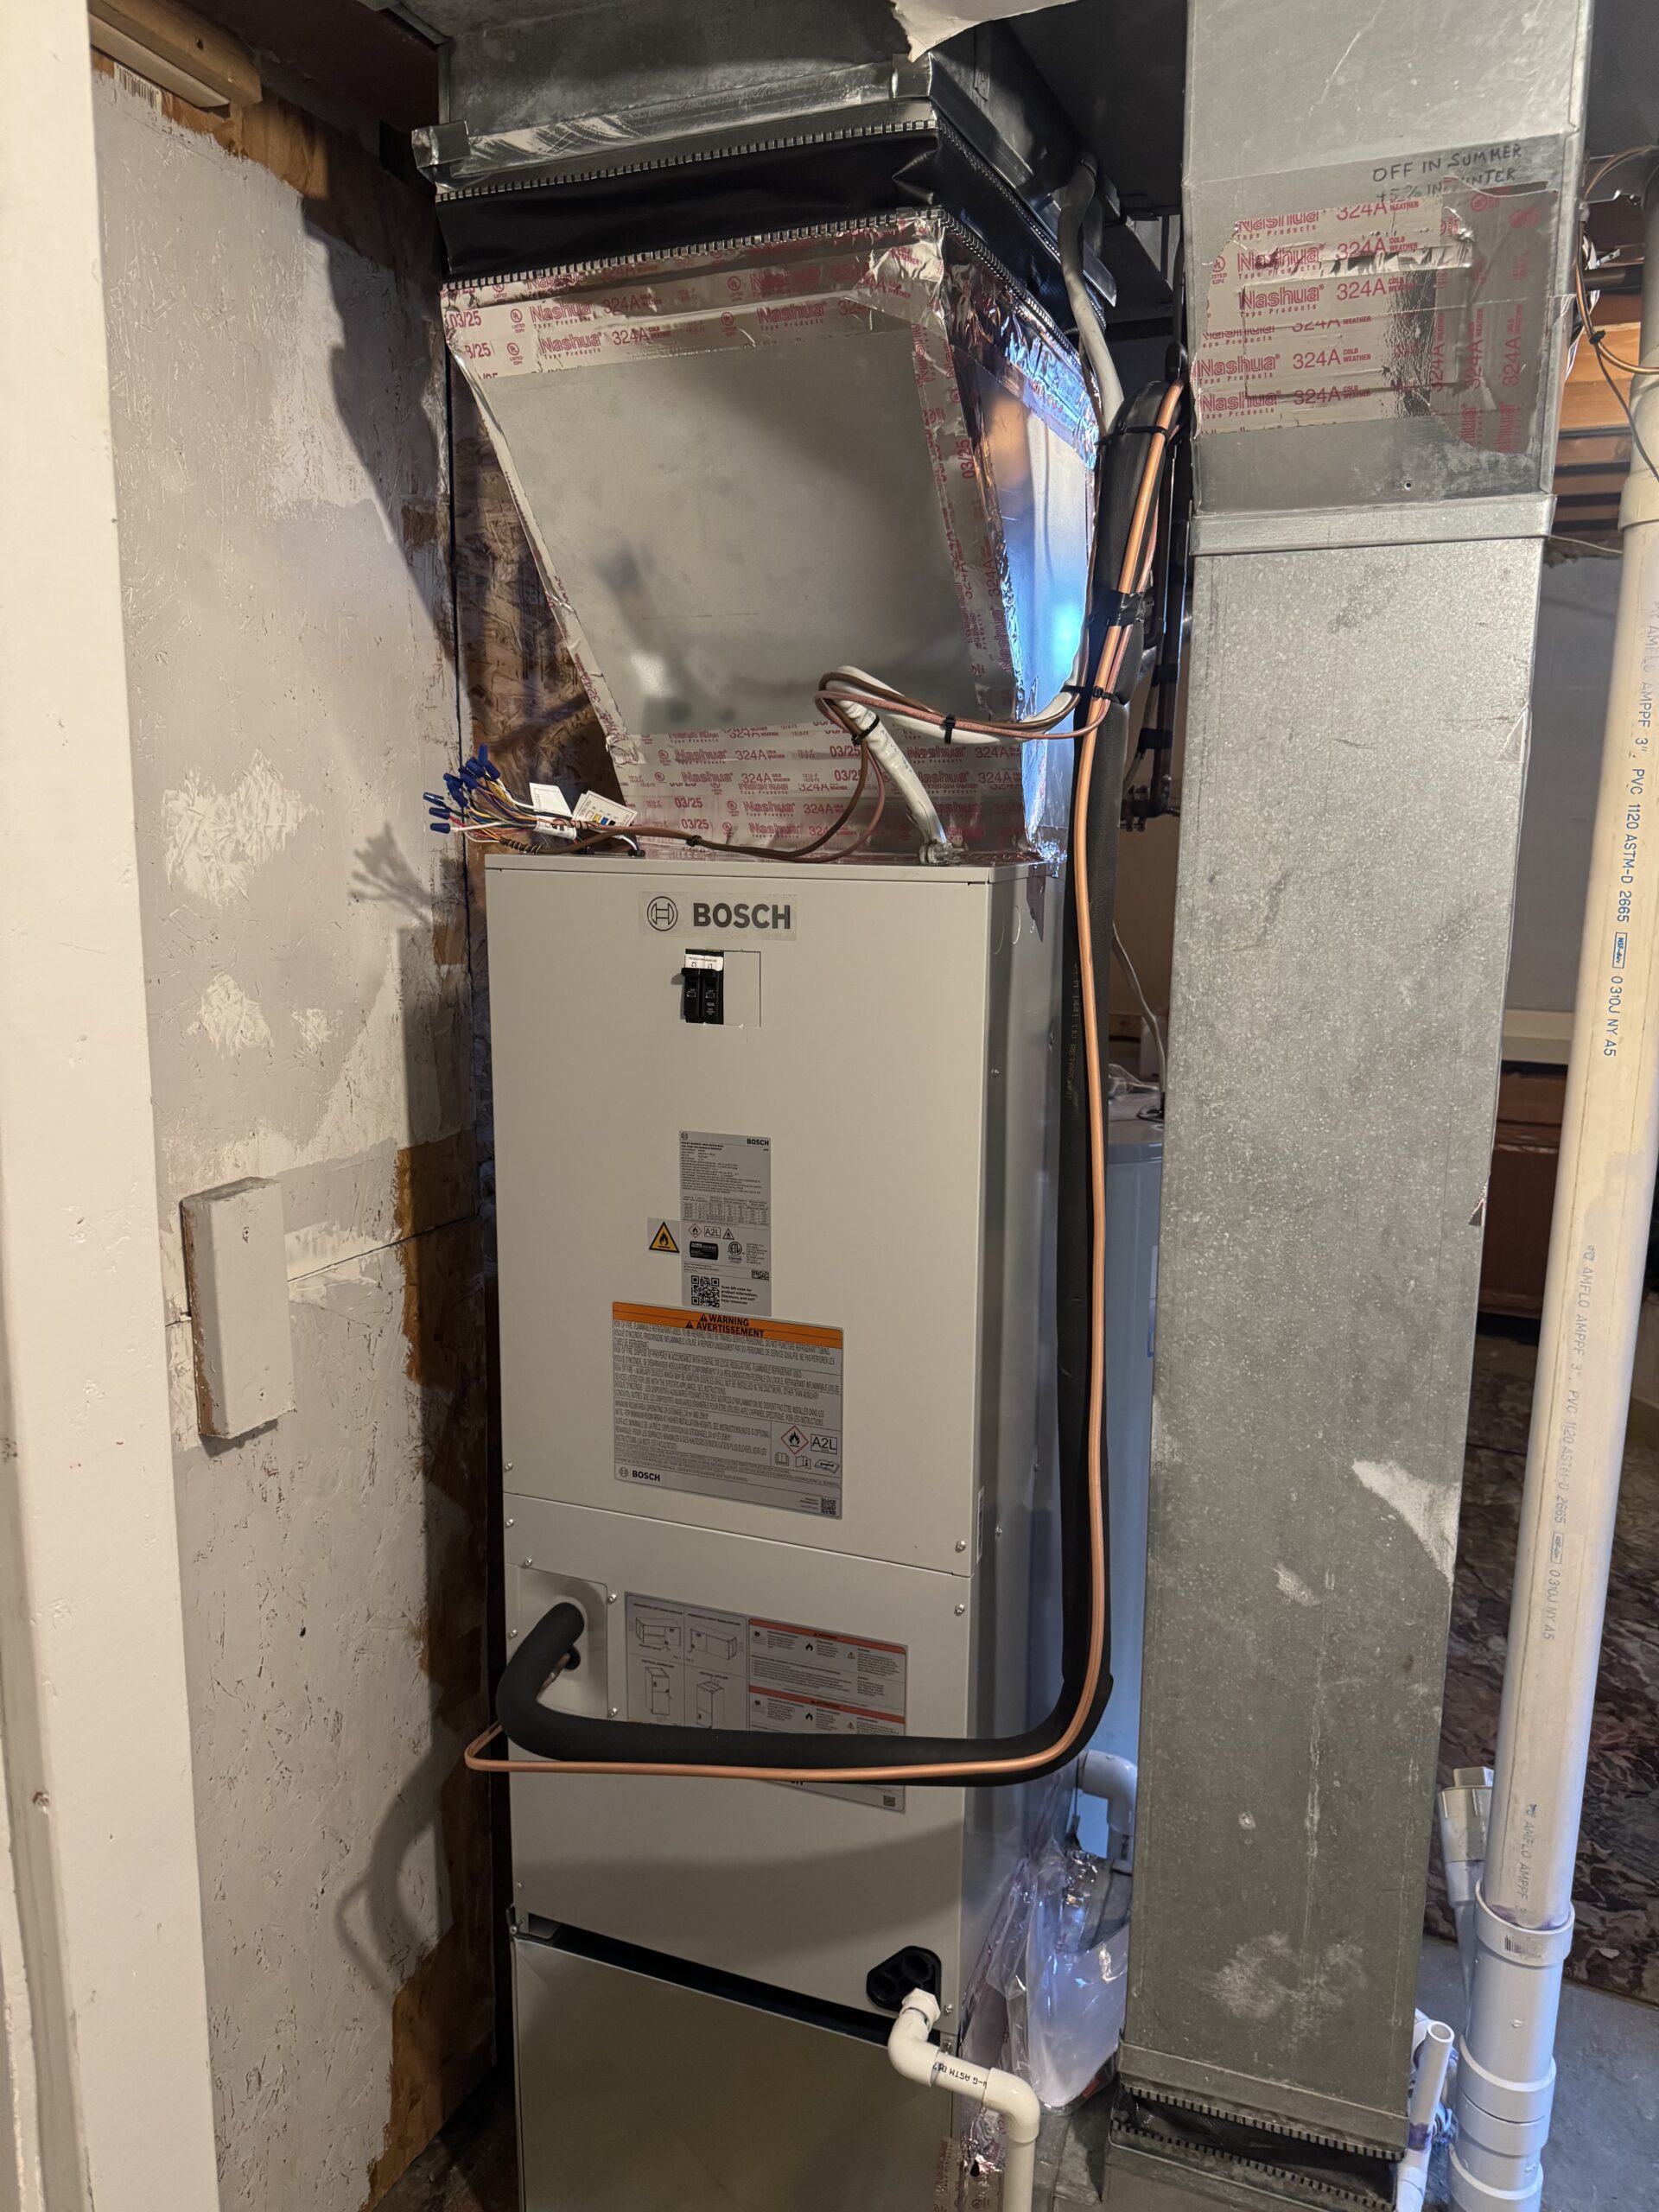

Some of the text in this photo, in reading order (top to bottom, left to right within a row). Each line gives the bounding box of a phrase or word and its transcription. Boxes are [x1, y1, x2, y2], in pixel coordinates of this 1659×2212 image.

[1373, 143, 1522, 182] OFF IN SUMMER
[1427, 181, 1442, 195] IN
[1389, 200, 1419, 211] WEATHER
[1267, 225, 1316, 236] Products
[1337, 238, 1386, 260] 324A
[1389, 243, 1418, 251] WEATHER
[1239, 278, 1386, 310] Nashua 324A
[449, 310, 481, 327] 03/25
[530, 302, 591, 322] Nashua
[757, 302, 825, 324] Nashua
[1268, 304, 1317, 315] Products
[1343, 316, 1371, 325] WEATHER
[539, 334, 601, 354] Nashua
[612, 328, 648, 346] 324A
[1226, 336, 1273, 346] Products
[1194, 348, 1341, 378] Nashua 324A
[1343, 354, 1371, 363] WEATHER
[1503, 336, 1522, 387] 324A
[1228, 372, 1273, 382] Products
[1199, 385, 1341, 412] Nashua 324A
[1229, 408, 1274, 417] Products
[956, 439, 976, 479] 03/25
[1638, 682, 1652, 728] AMPPF
[675, 746, 861, 760] Nashua 324A 03/25
[907, 747, 1010, 759] Nashua 324A
[681, 772, 733, 783] Nashua
[741, 772, 772, 783] 324A
[978, 772, 1013, 784] 324A
[1630, 768, 1645, 795] PVC
[675, 798, 834, 814] 03/25 Nashua 324A
[682, 819, 709, 830] 03/25
[1626, 804, 1641, 830] 1120
[1621, 834, 1637, 884] ASTM-D
[1617, 891, 1632, 923] 2665
[694, 902, 791, 930] BOSCH
[1606, 1019, 1618, 1035] NY
[1604, 1039, 1617, 1057] A5
[705, 1228, 720, 1236] A2L
[1578, 1266, 1593, 1308] AMFLO
[709, 1314, 749, 1327] WARNING
[696, 1323, 765, 1338] AVERTISSEMENT
[1573, 1313, 1588, 1357] AMPPF
[1566, 1389, 1580, 1414] PVC
[811, 1438, 837, 1452] A2L
[632, 1470, 661, 1482] BOSCH
[1558, 1446, 1573, 1491] ASTM-D
[1554, 1495, 1568, 1524] 2665
[1542, 1624, 1555, 1640] A5
[1516, 1821, 1535, 1901] AMFLO AMPPF
[950, 2068, 970, 2082] ASTM
